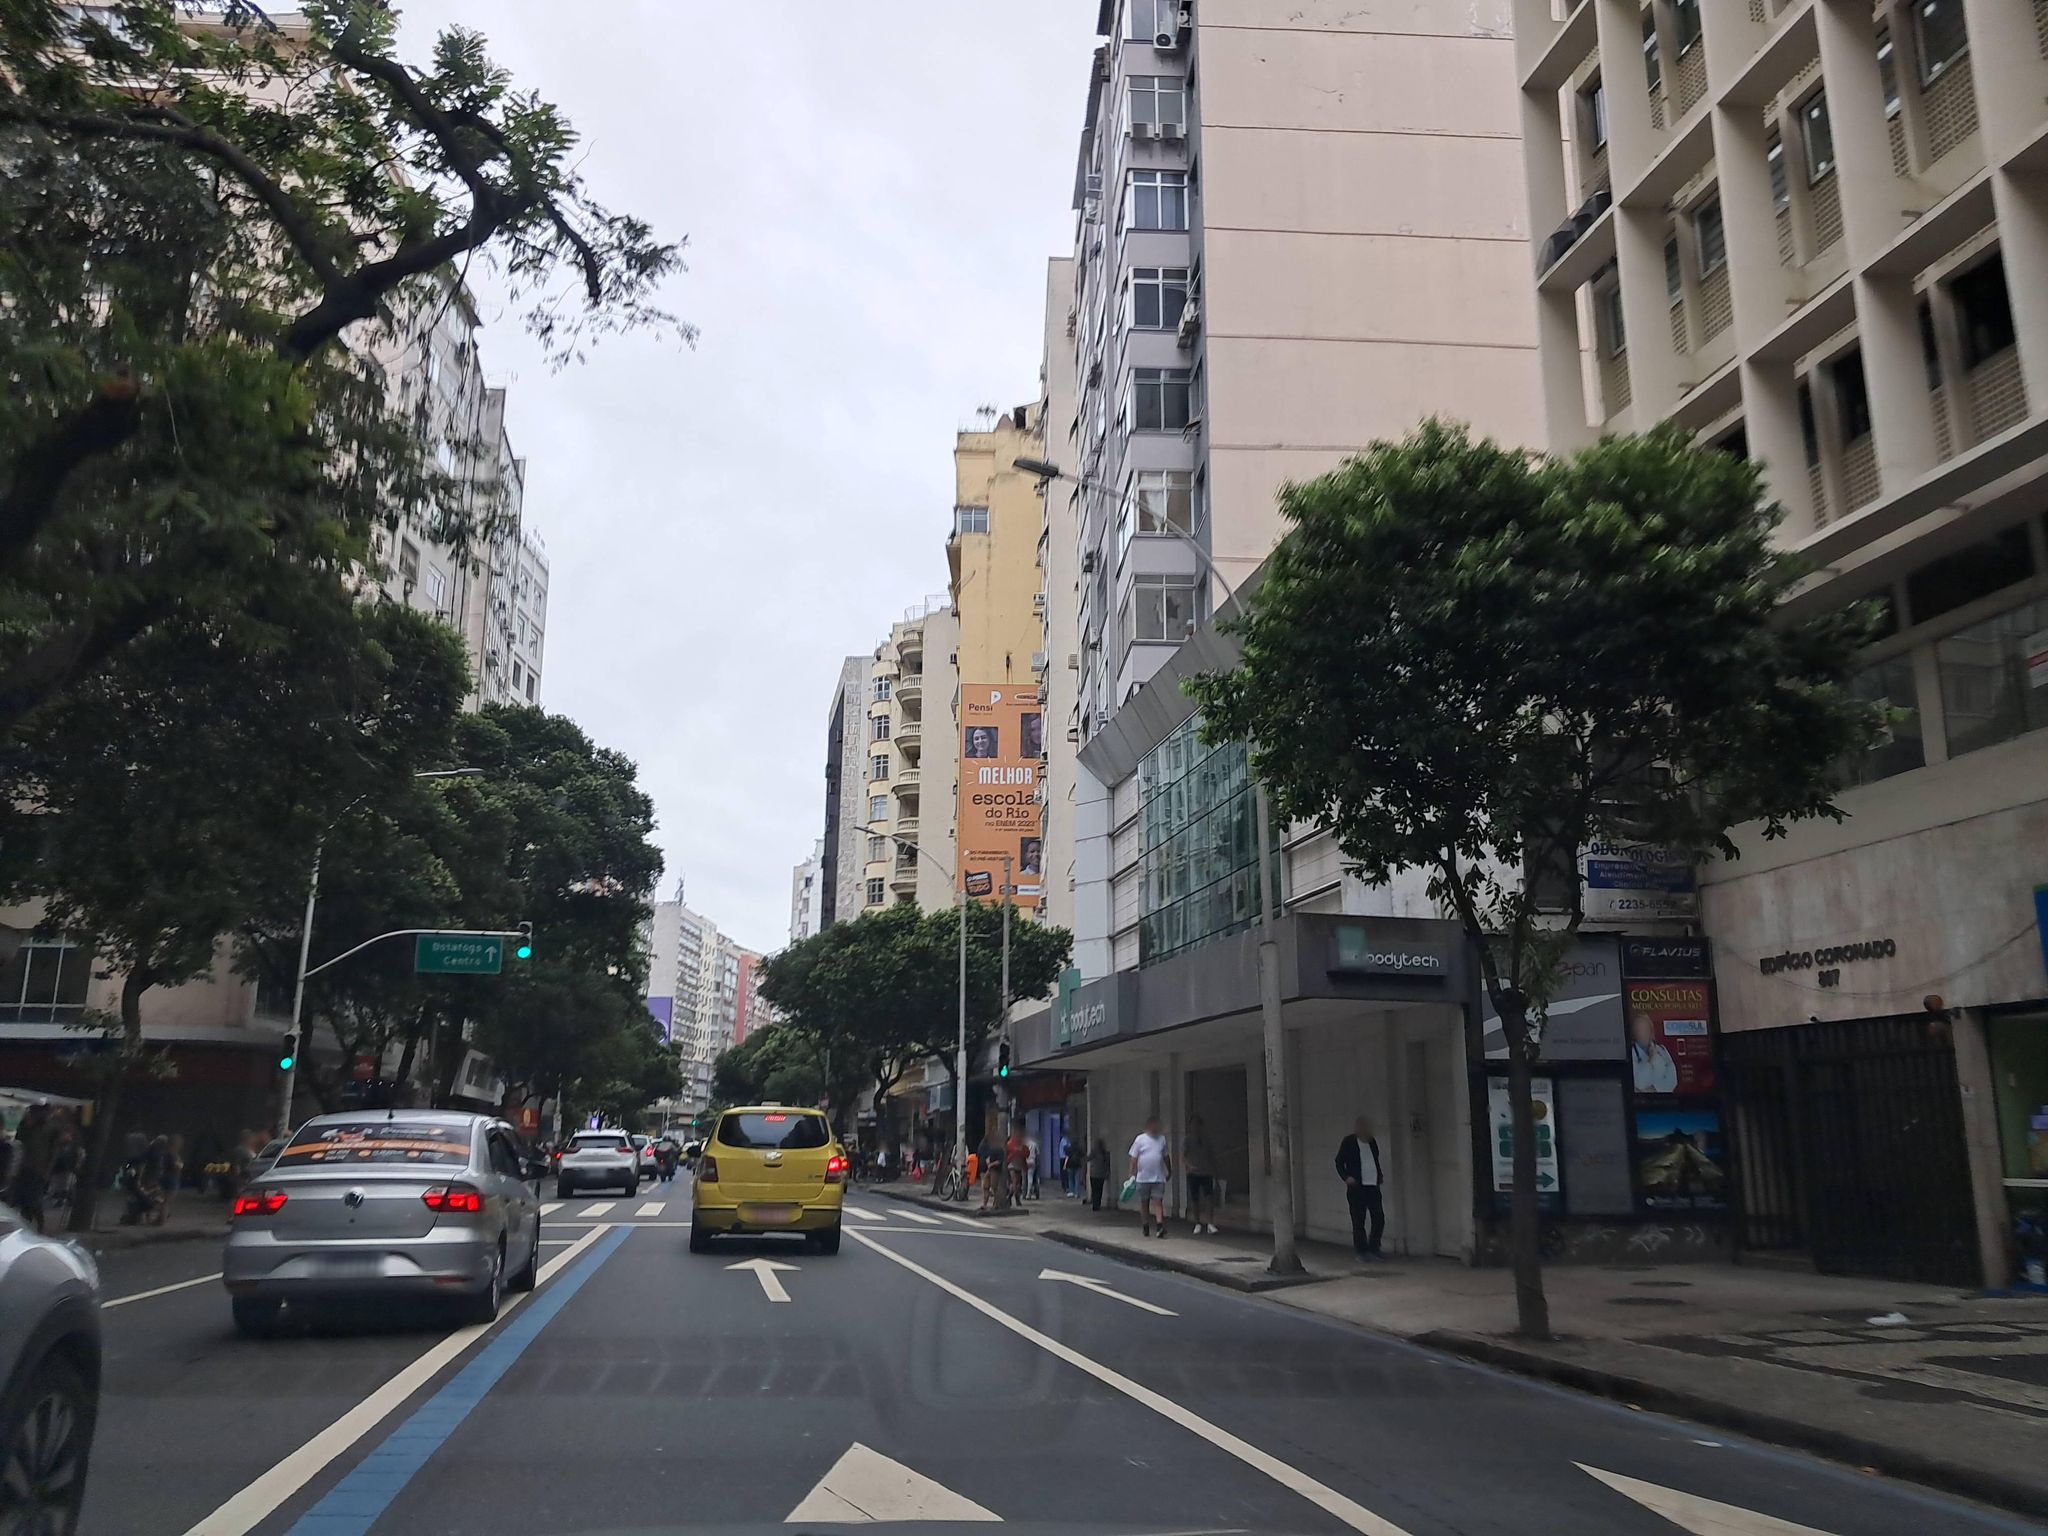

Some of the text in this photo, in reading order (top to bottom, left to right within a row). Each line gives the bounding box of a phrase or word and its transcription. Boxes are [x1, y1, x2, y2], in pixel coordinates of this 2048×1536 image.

[968, 703, 993, 712] Pensi
[978, 766, 1033, 785] MELHOR
[972, 790, 1035, 806] escola
[985, 807, 1029, 819] do Rio
[432, 942, 482, 954] Botafogo
[1642, 946, 1702, 957] FLAVIUS
[443, 956, 481, 966] Centro
[1366, 951, 1440, 970] bodytech
[1760, 938, 1897, 975] EDIFÍCIO CORONADO
[1630, 988, 1703, 1002] CONSULTAS
